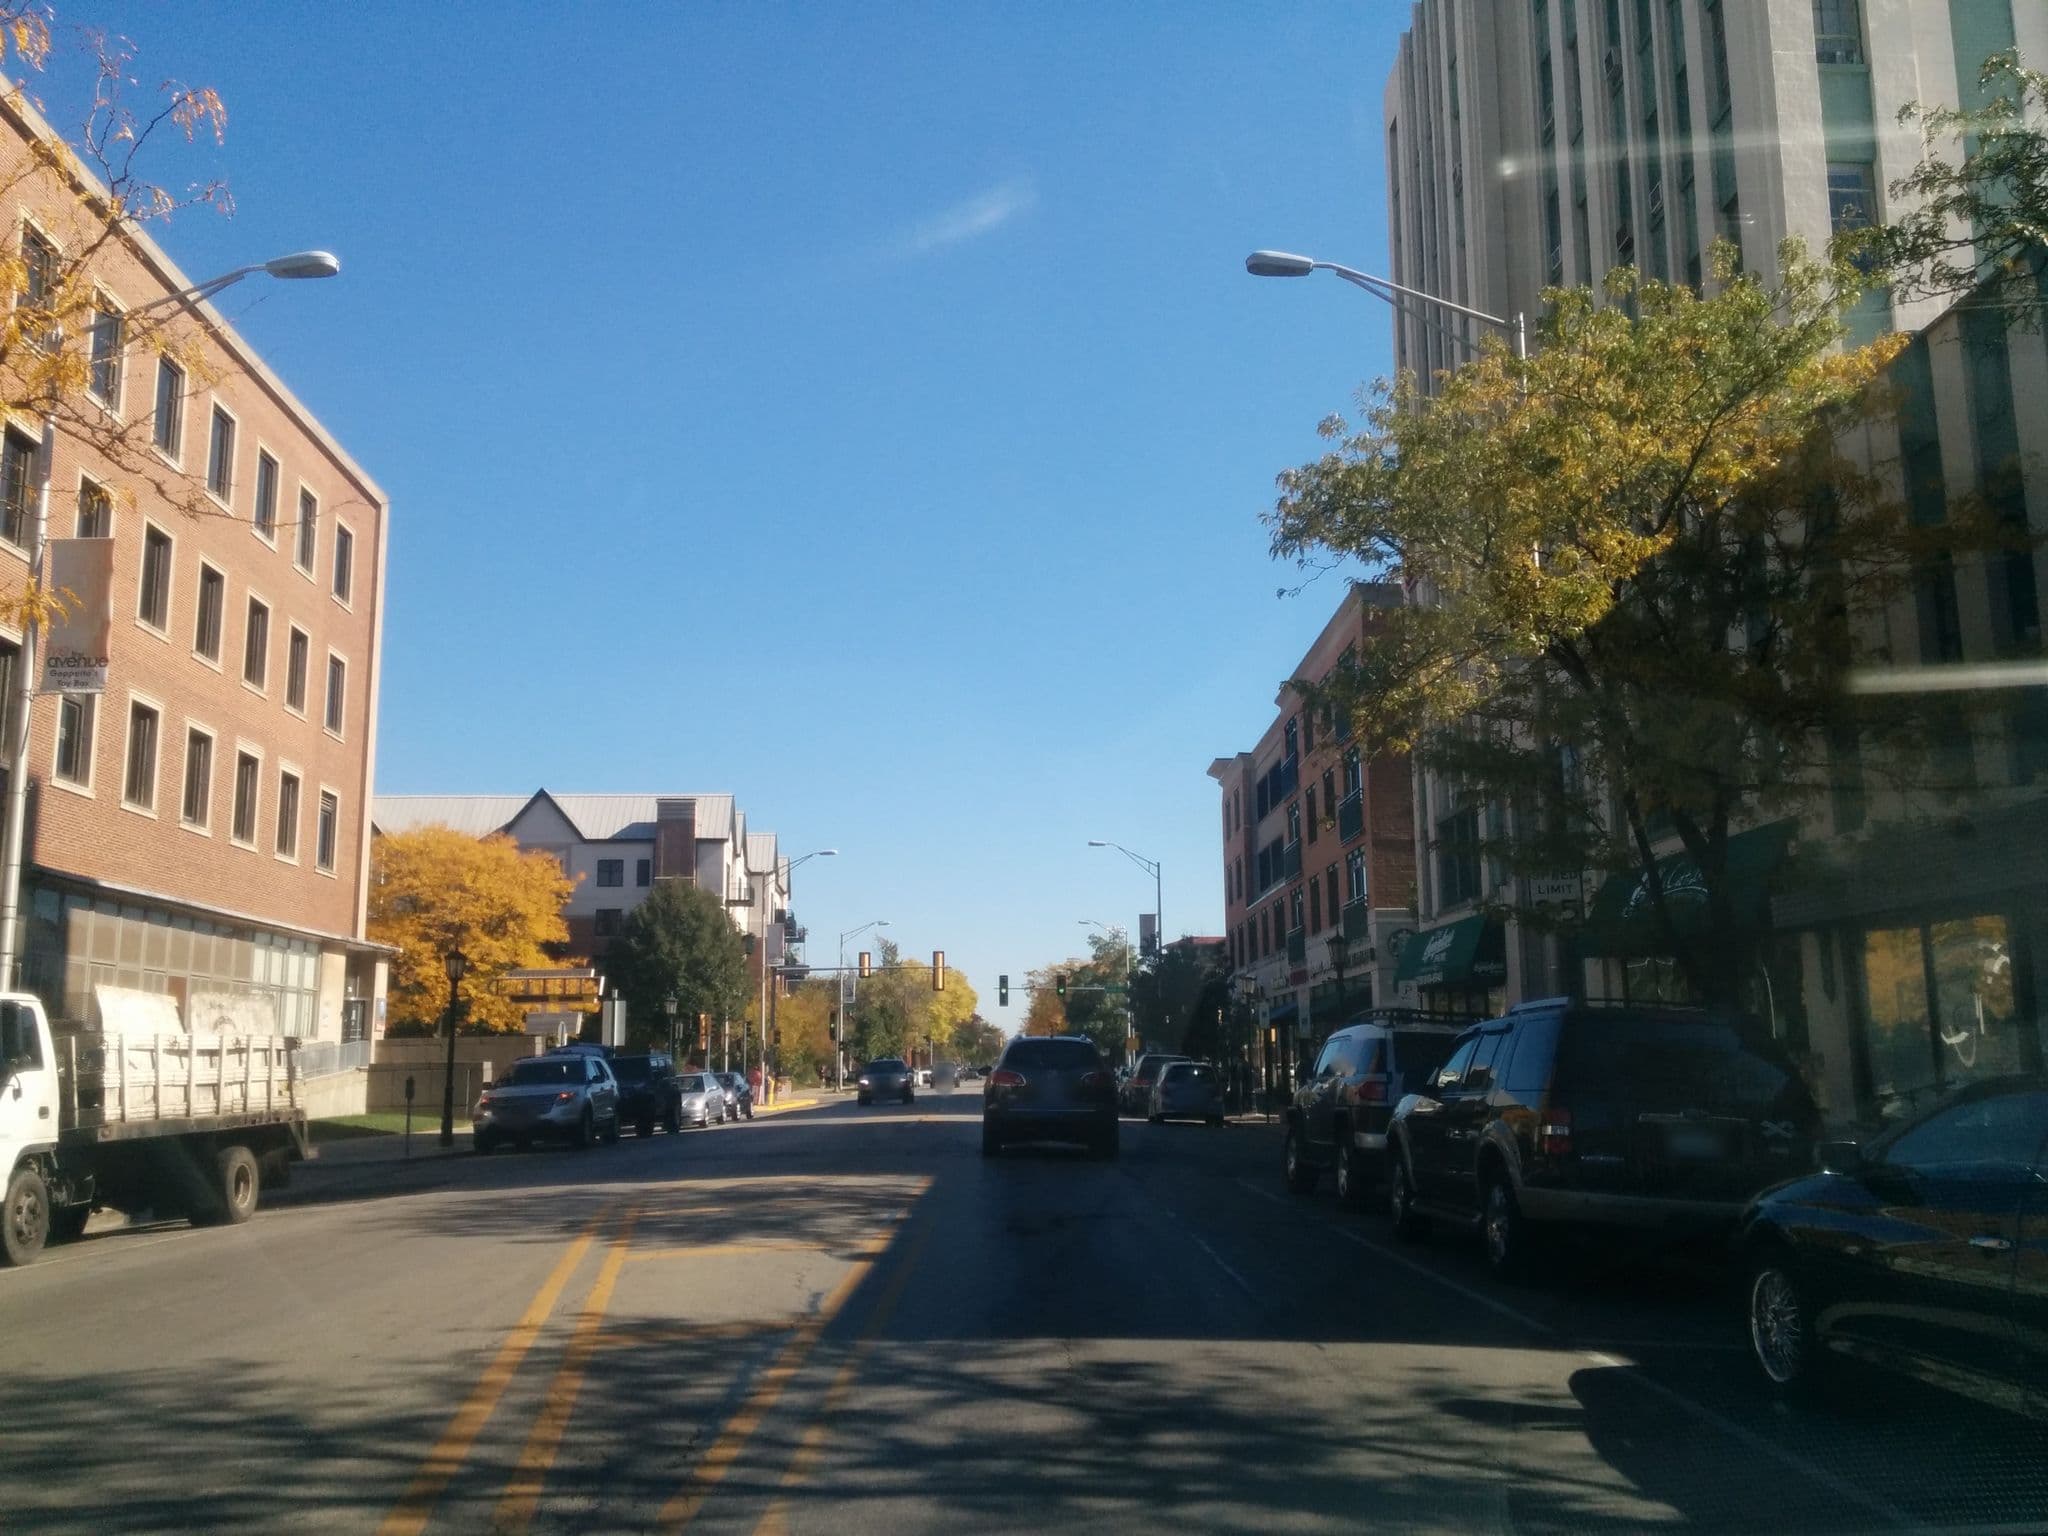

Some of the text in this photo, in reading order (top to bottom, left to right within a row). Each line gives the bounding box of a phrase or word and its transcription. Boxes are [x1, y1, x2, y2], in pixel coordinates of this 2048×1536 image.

[47, 656, 108, 668] avenue
[56, 679, 89, 687] Toy Box
[1537, 884, 1573, 895] LIMIT
